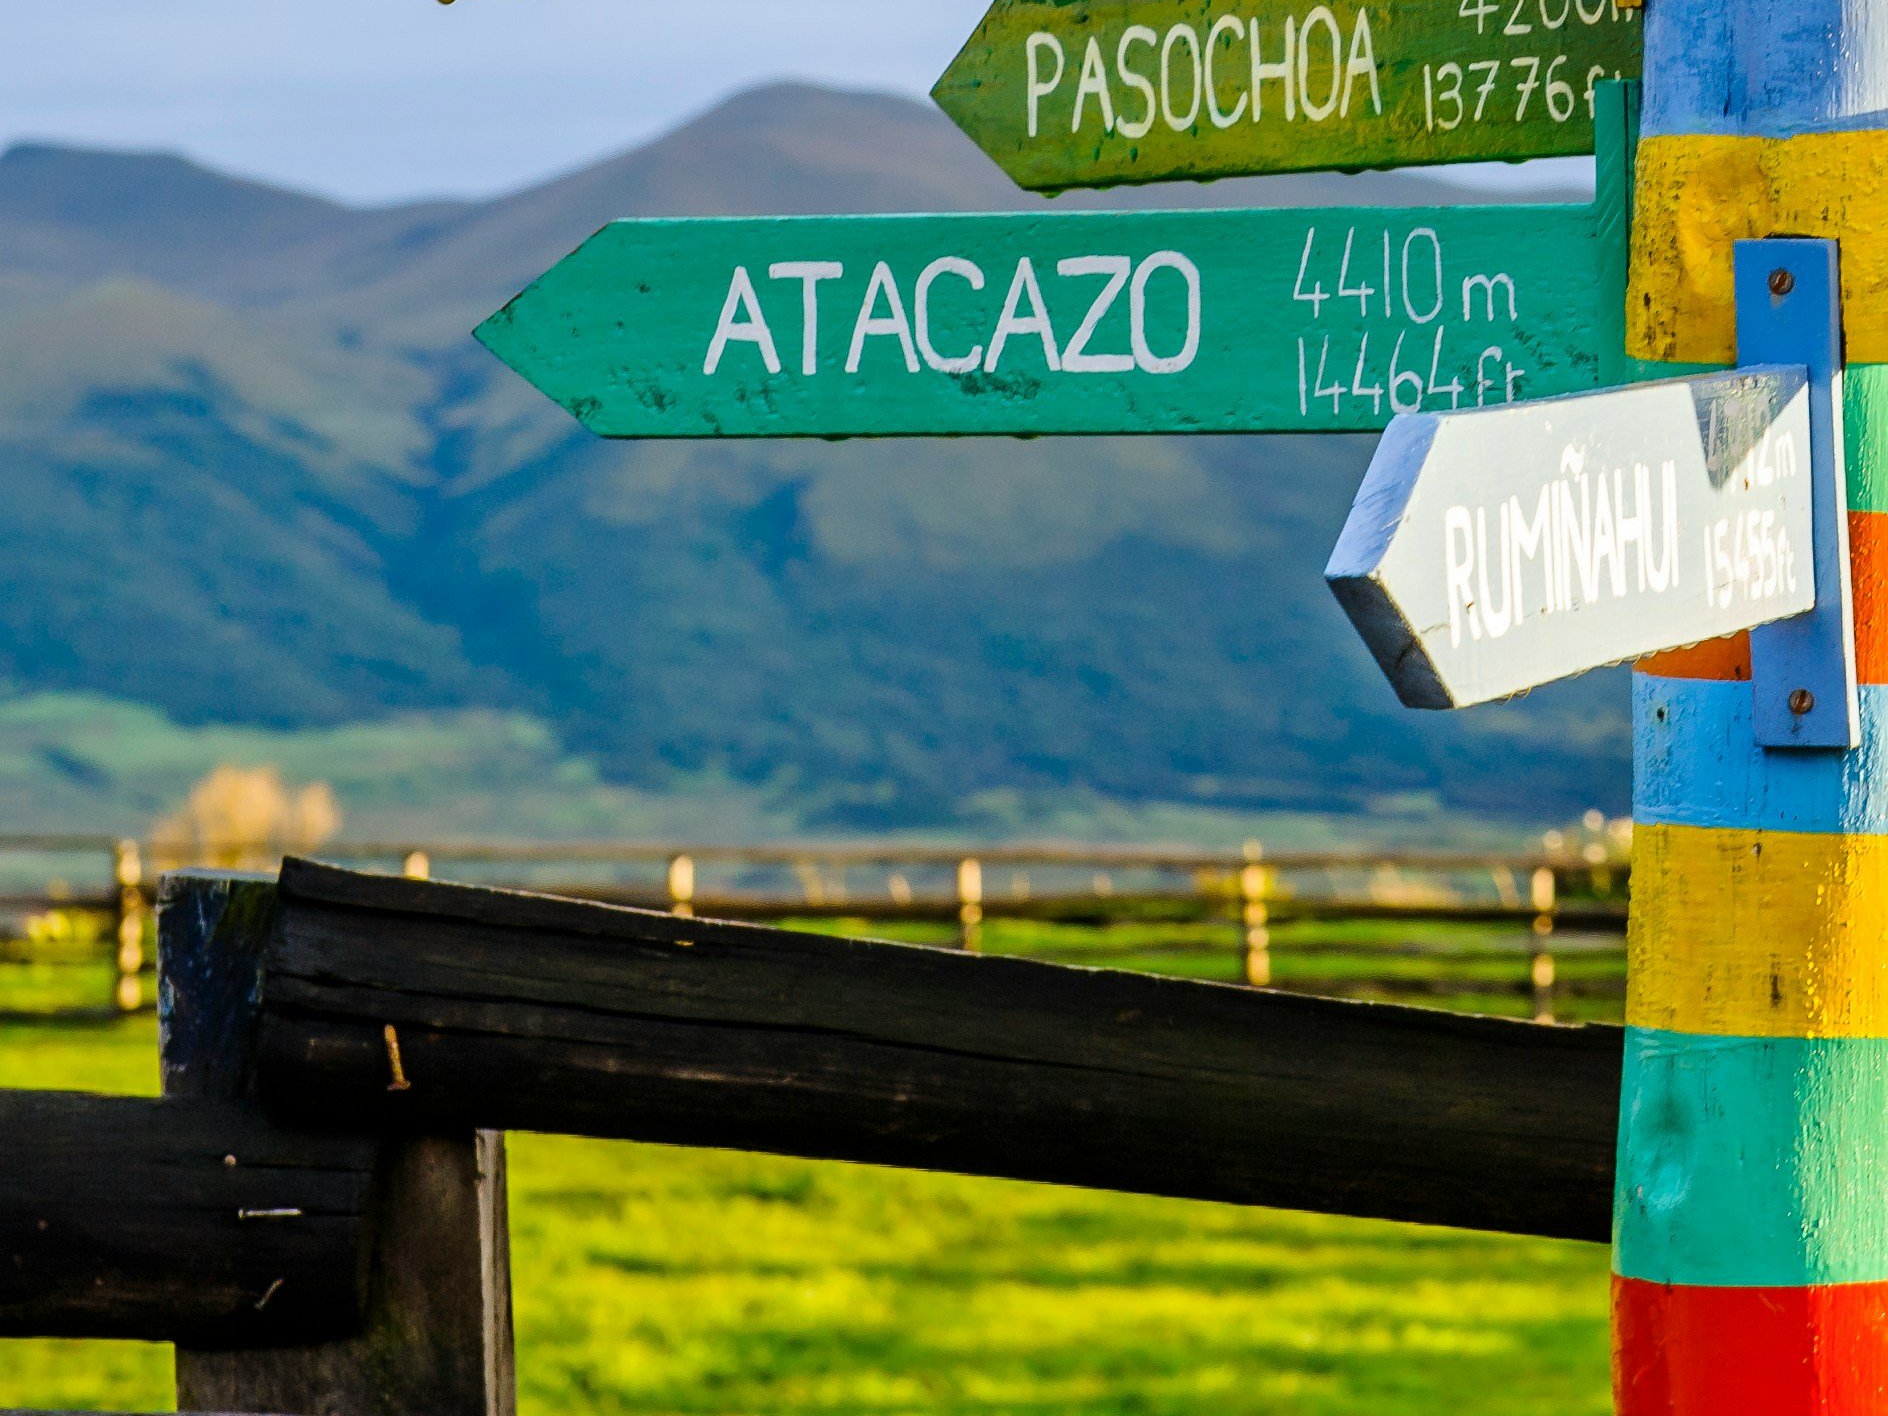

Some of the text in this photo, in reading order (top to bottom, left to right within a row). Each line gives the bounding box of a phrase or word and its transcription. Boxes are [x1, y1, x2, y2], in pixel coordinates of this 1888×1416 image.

[1027, 5, 1382, 139] PASOCHOA
[1424, 54, 1621, 132] 13776f
[703, 250, 1200, 376] ATACAZO
